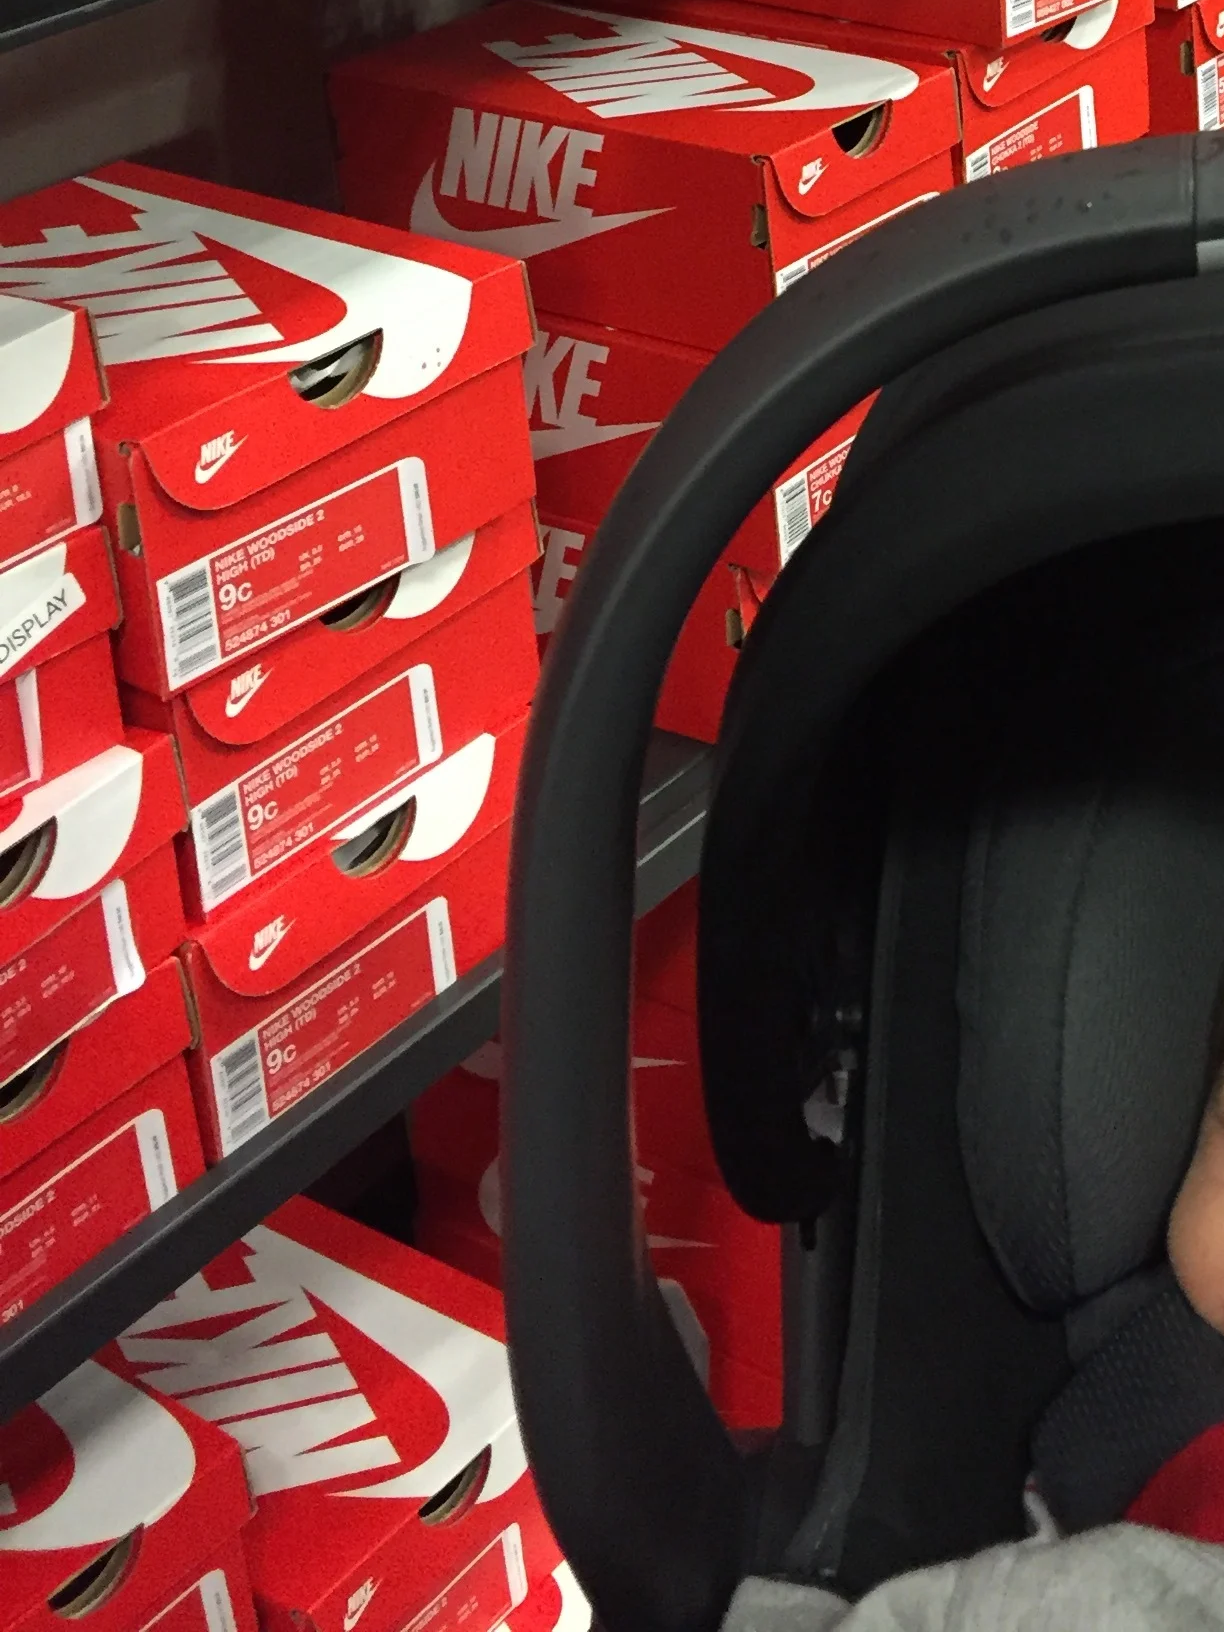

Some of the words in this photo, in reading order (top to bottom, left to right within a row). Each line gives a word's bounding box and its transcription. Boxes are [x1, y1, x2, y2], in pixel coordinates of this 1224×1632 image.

[440, 106, 604, 220] NIKE
[200, 430, 235, 467] NIKE
[809, 463, 828, 482] NIKE
[811, 489, 833, 512] 7c
[214, 548, 245, 572] NIKE
[246, 515, 315, 553] WOODSIDE
[316, 509, 325, 522] 2
[217, 559, 249, 585] HIGH
[250, 546, 276, 571] (TD)
[218, 581, 253, 612] 9c
[0, 588, 69, 665] DISPLAY
[225, 620, 268, 652] 524874
[270, 609, 291, 629] 301
[230, 662, 264, 699] NIKE
[243, 772, 272, 795] NIKE
[272, 730, 334, 776] WOODSIDE
[334, 723, 343, 736] 2
[245, 780, 275, 807] HIGH
[275, 764, 299, 789] (TD)
[247, 800, 279, 831] 9c
[254, 834, 294, 870] 524874
[294, 821, 314, 842] 301
[253, 914, 285, 953] NIKE
[262, 1014, 290, 1040] NIKE
[291, 971, 352, 1021] WOODSIDE
[353, 963, 361, 977] 2
[264, 1023, 294, 1051] HIGH
[266, 1044, 297, 1075] 9c
[311, 1060, 332, 1082] 301
[1, 1299, 25, 1323] 301
